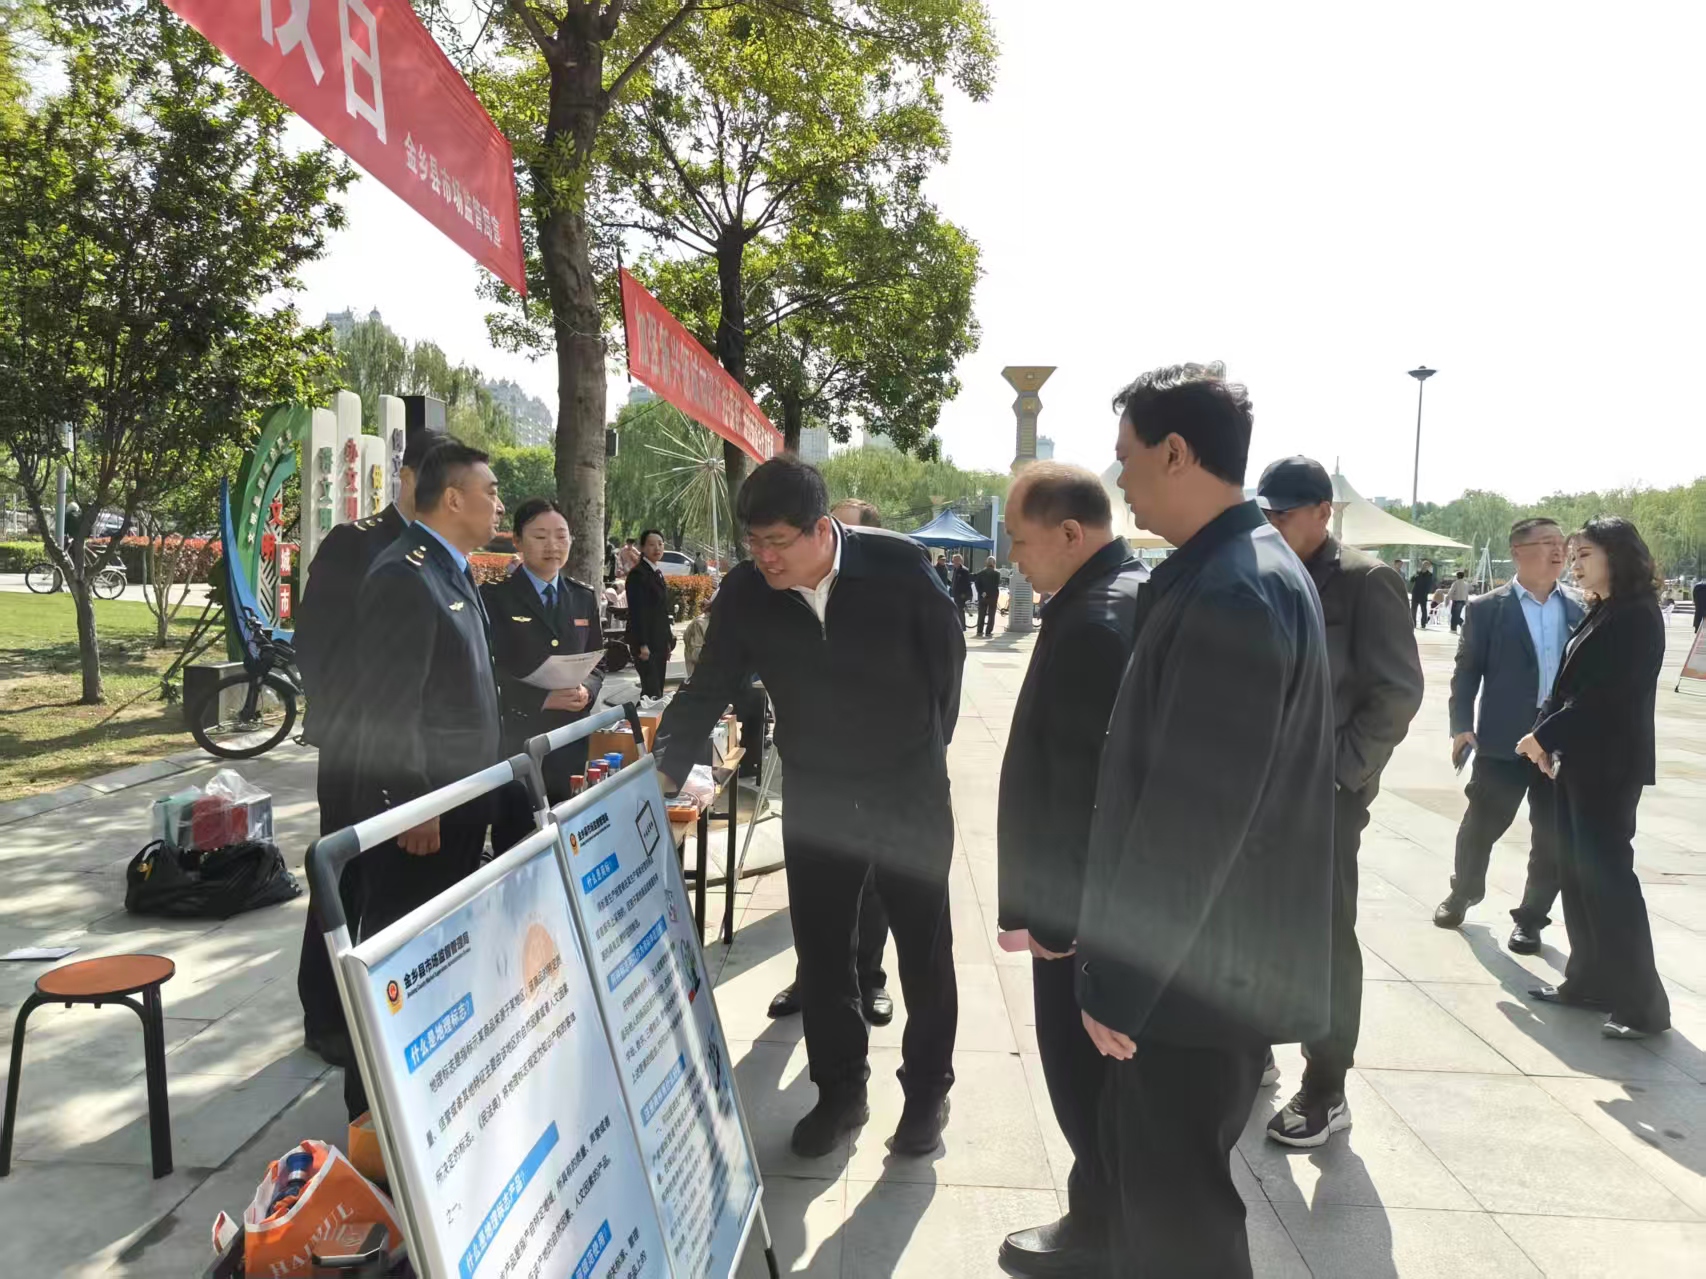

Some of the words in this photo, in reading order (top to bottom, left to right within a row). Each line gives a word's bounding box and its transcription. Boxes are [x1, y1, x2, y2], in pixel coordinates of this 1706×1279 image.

[404, 131, 502, 249] 金乡县市场监管局宣
[262, 498, 285, 562] 文明
[280, 548, 292, 614] 城市
[404, 931, 470, 990] 金乡县市场监督管理局
